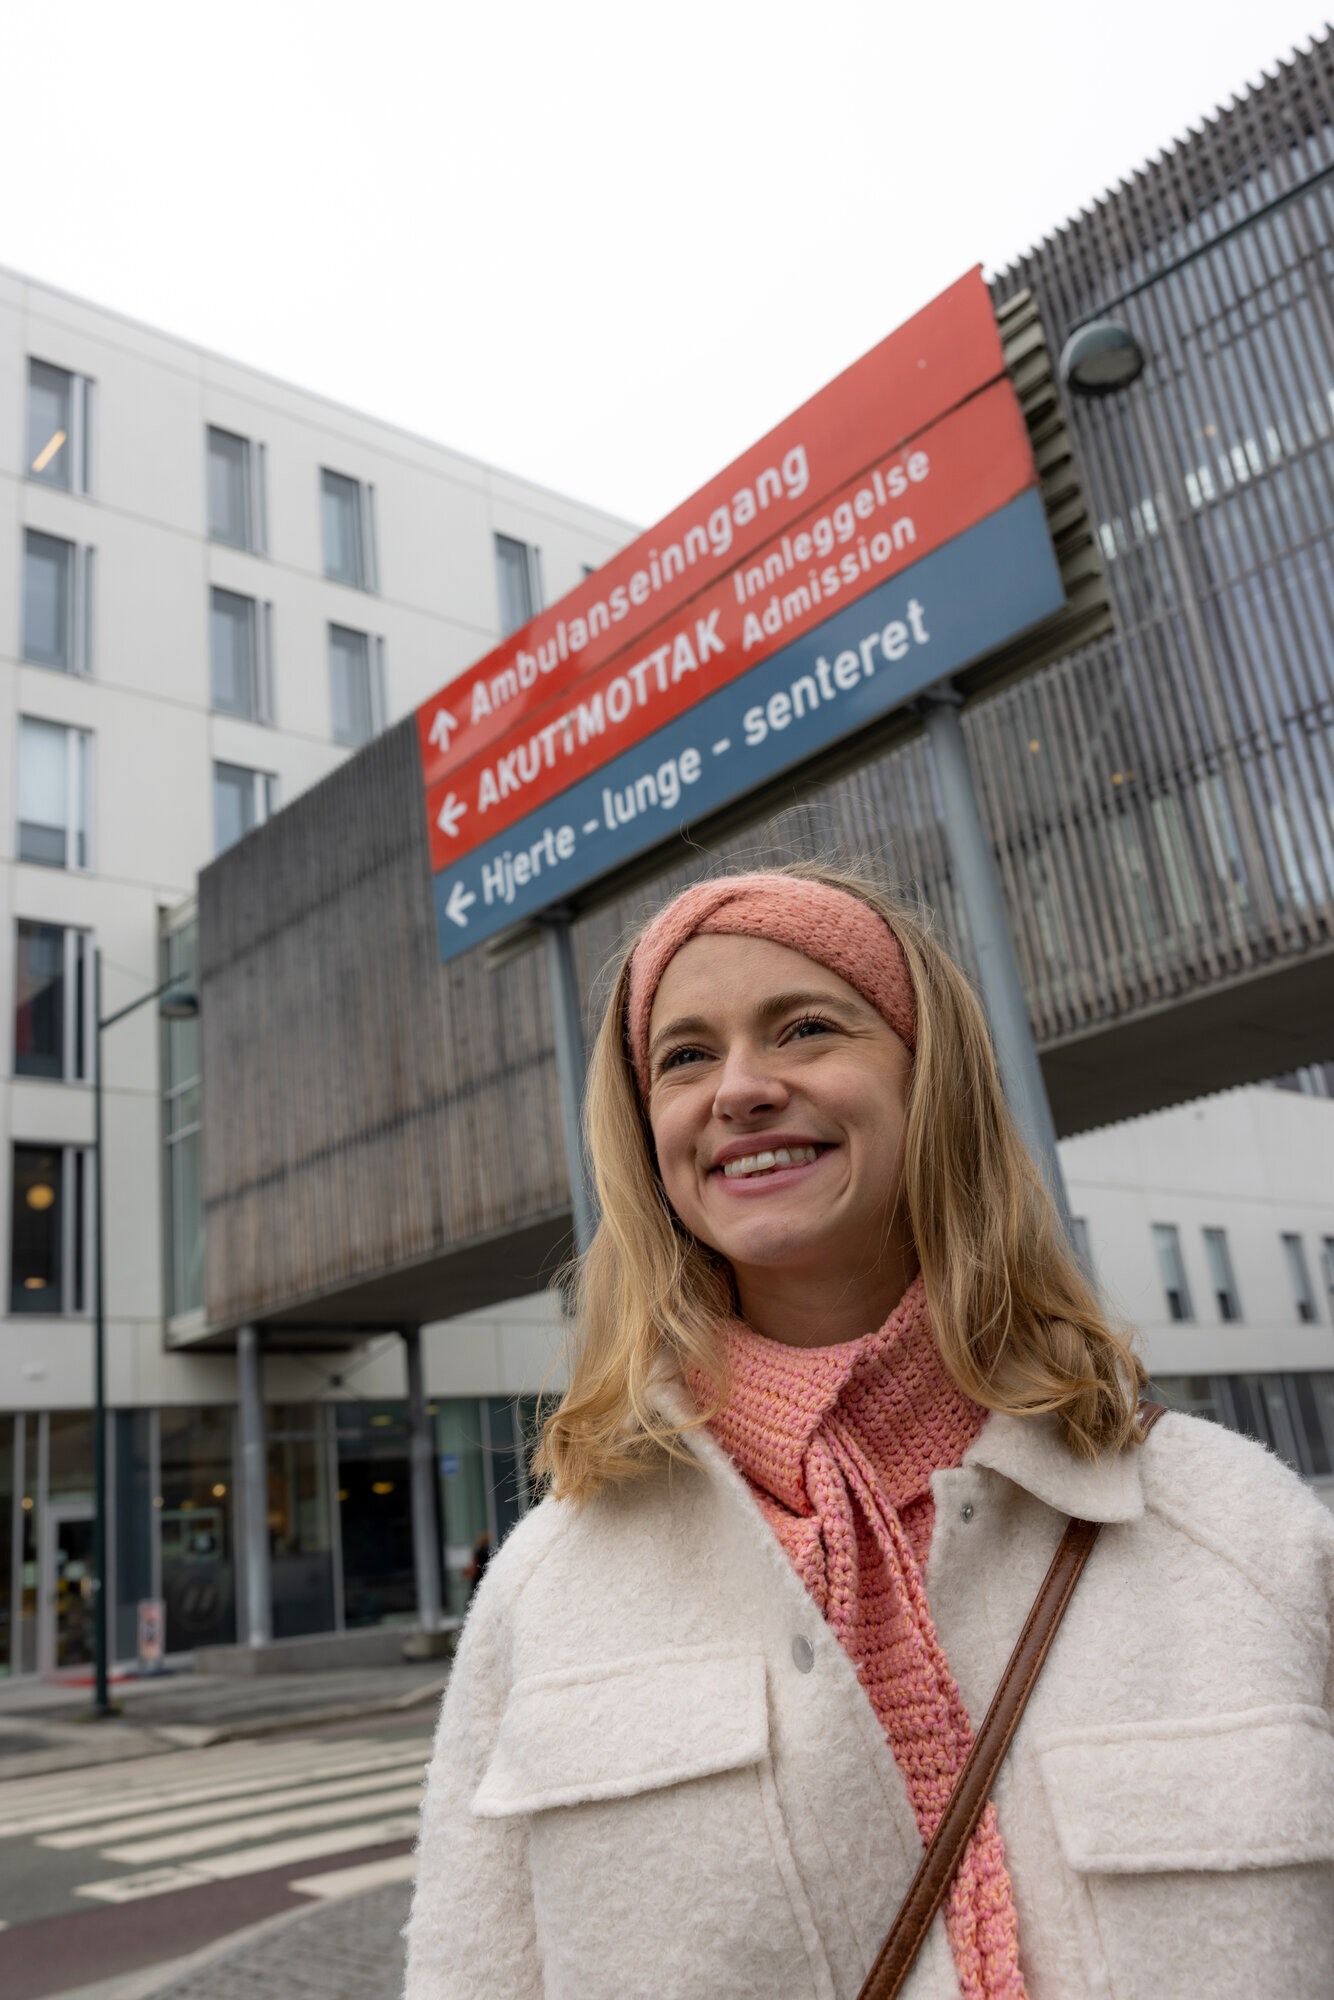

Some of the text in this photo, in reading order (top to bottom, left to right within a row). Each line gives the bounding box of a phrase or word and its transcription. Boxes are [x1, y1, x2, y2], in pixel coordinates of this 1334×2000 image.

[470, 444, 809, 725] Ambulanseinngang
[733, 450, 930, 604] Innleggelse
[742, 516, 916, 650] Admission
[477, 608, 726, 813] AKUTTMOTTAK
[481, 827, 575, 904] Hjerte
[743, 599, 929, 746] senteret
